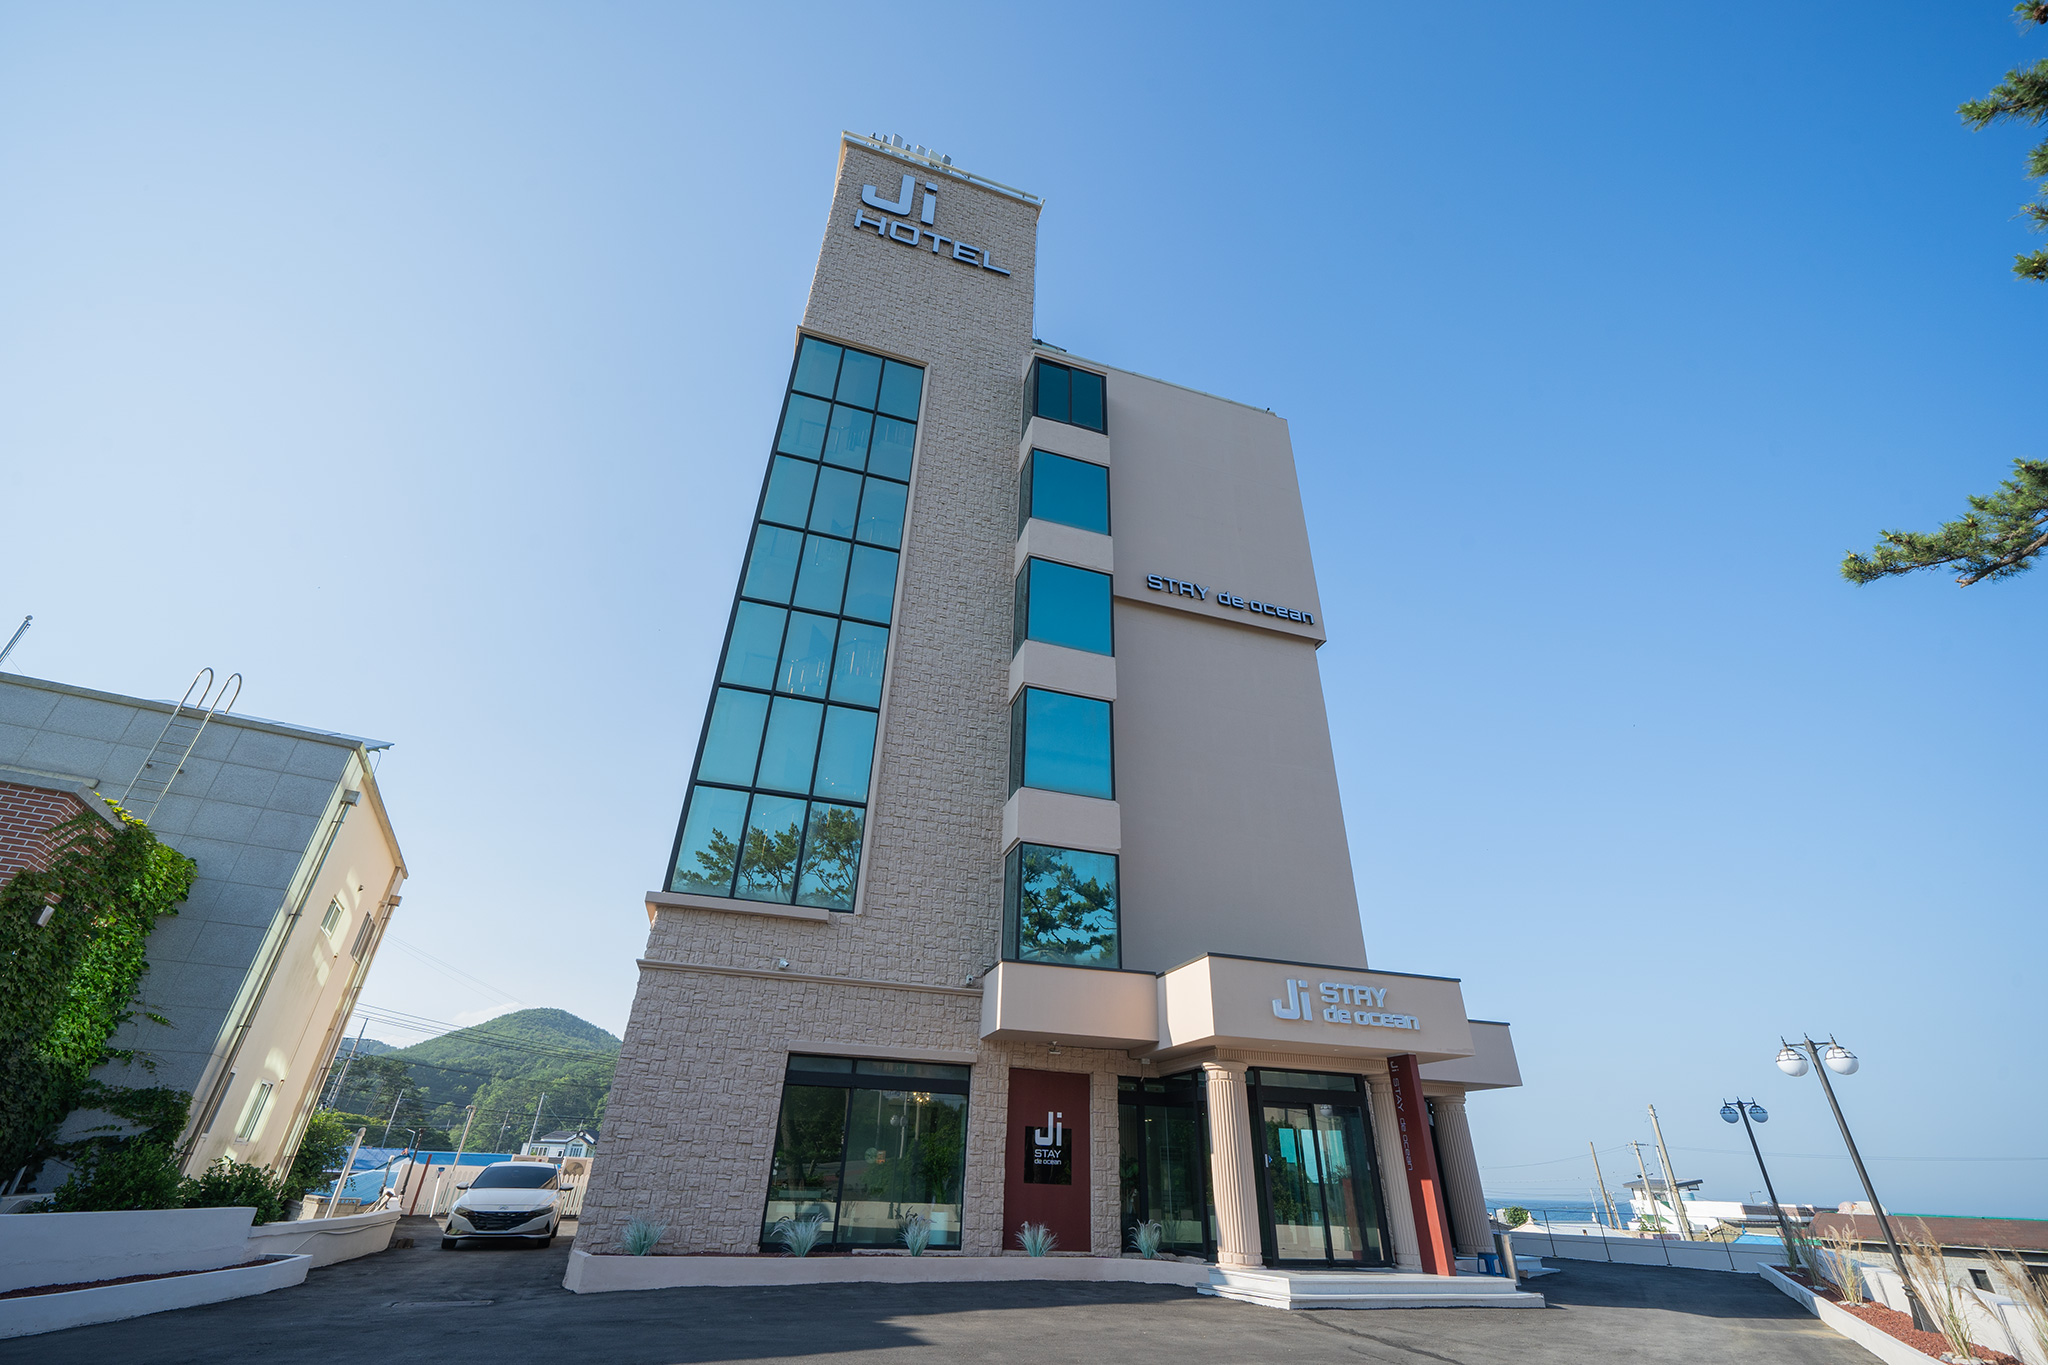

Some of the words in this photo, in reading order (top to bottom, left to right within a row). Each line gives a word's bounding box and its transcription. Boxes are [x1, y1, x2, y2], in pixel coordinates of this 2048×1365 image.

[861, 174, 938, 226] Ji
[853, 209, 1011, 276] HOTEL
[1147, 574, 1209, 601] STAY
[1217, 591, 1244, 610] de
[1249, 600, 1315, 626] ocean
[1272, 979, 1313, 1021] Ji
[1319, 982, 1388, 1008] STAY
[1323, 1005, 1351, 1024] de
[1354, 1011, 1421, 1030] ocean
[1035, 1111, 1062, 1146] Ji
[1393, 1078, 1404, 1112] STAY
[1400, 1118, 1406, 1132] de
[1403, 1134, 1413, 1171] ocean
[1034, 1149, 1061, 1158] STAY
